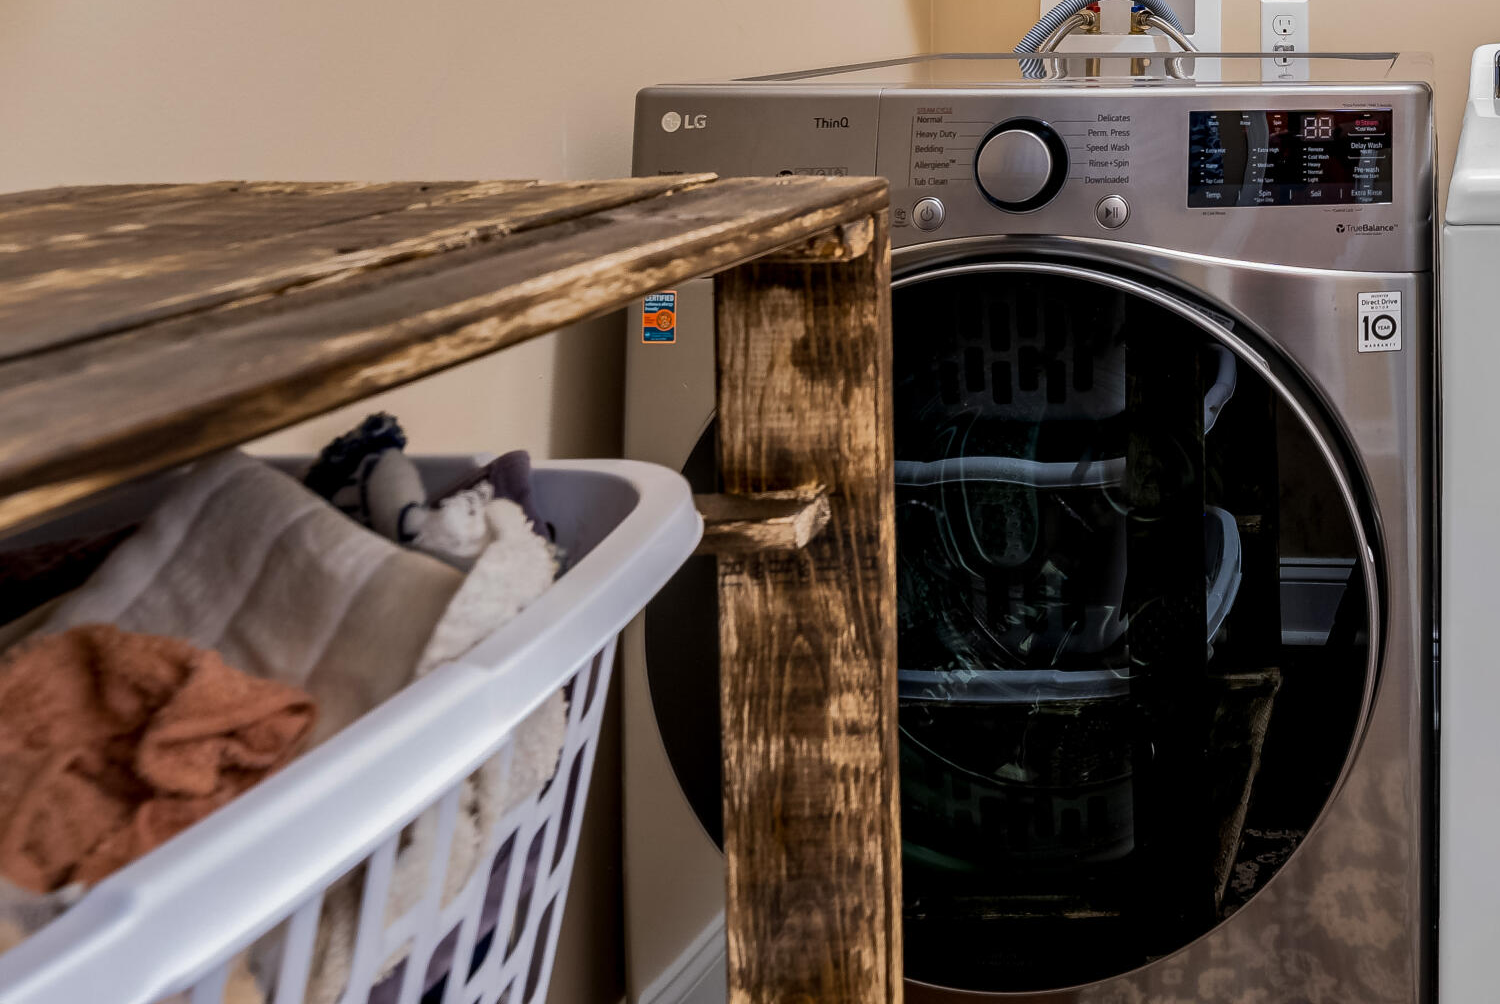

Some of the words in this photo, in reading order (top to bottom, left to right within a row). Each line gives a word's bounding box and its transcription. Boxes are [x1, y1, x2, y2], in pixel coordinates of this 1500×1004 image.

[684, 114, 707, 129] LG
[814, 116, 849, 129] ThinQ
[916, 116, 943, 124] Normal
[1097, 114, 1131, 122] Delicates
[915, 130, 938, 140] Heavy
[939, 130, 957, 139] Duty
[1087, 128, 1109, 137] Perm.
[1110, 128, 1131, 137] Press
[914, 145, 944, 154] Bedding
[1086, 143, 1109, 153] Speed
[1110, 143, 1130, 152] Wash
[1350, 142, 1367, 150] Delay
[913, 177, 926, 186] Tub
[927, 177, 949, 186] Clean
[1084, 176, 1130, 184] Downloaded
[1258, 189, 1272, 198] Spin
[645, 294, 675, 302] CERTIFIED
[1362, 313, 1397, 342] 10
